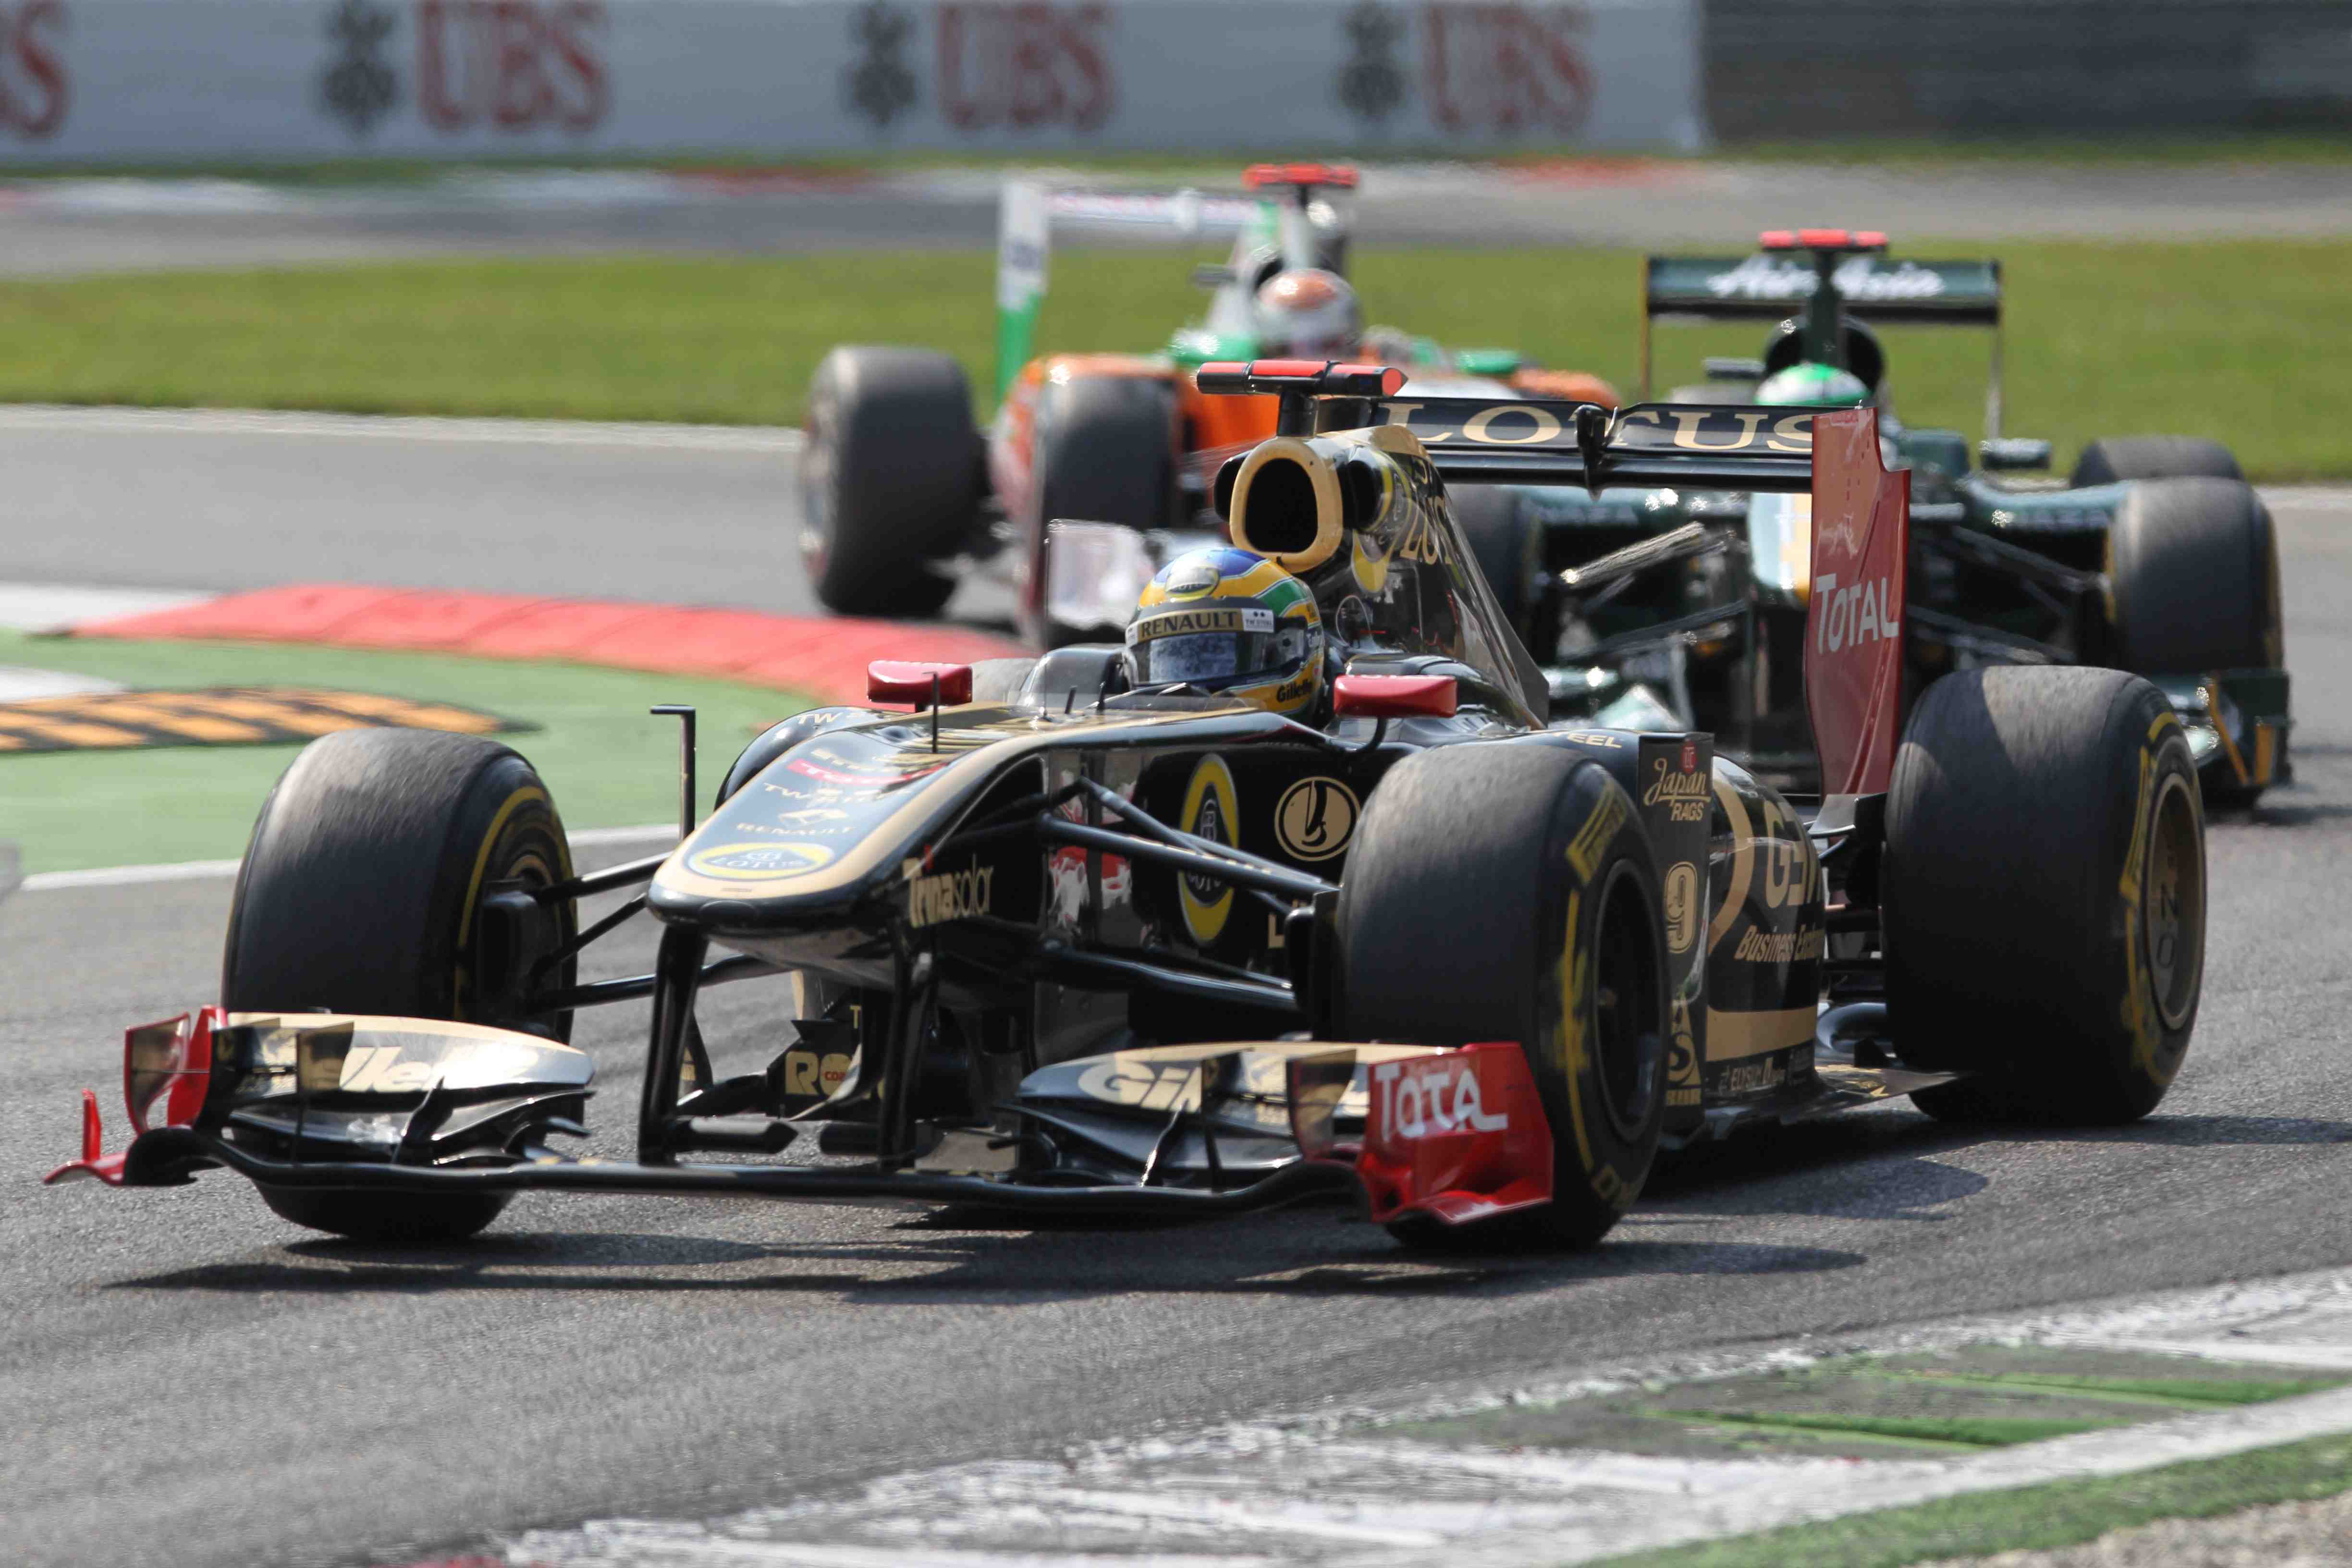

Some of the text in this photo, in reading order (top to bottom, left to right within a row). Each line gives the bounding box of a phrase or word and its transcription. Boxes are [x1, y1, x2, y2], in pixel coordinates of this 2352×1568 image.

[414, 0, 611, 133] UBS
[1141, 612, 1237, 638] RENAULT
[1816, 573, 1899, 655] TOTAL
[1643, 757, 1711, 807] Japan
[1670, 801, 1704, 821] RAGS
[1664, 861, 1698, 954] 9
[1376, 1064, 1508, 1143] TOTAL
